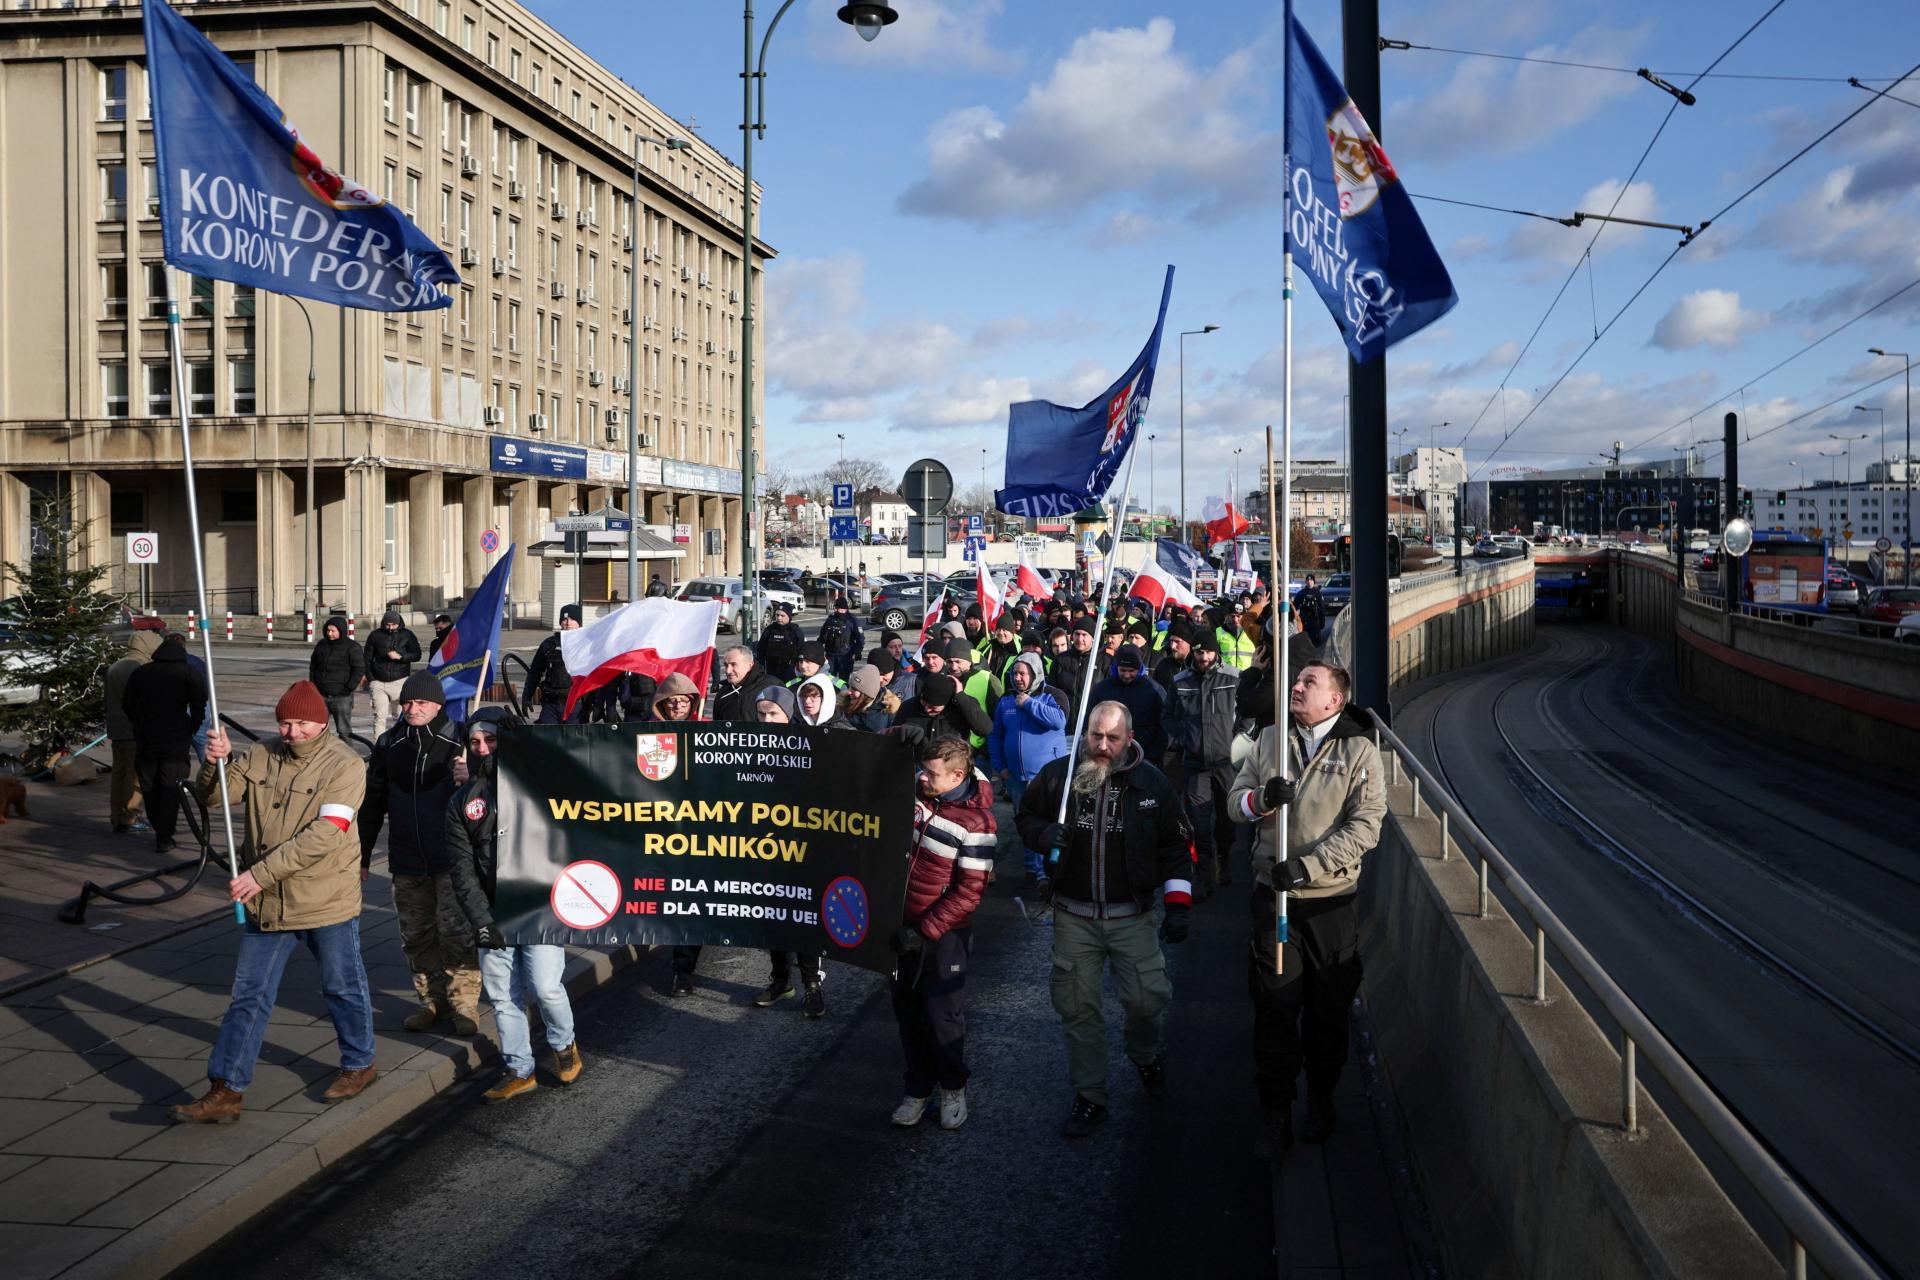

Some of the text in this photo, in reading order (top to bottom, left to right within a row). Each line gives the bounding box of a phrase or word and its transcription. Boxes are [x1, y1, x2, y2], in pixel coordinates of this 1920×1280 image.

[180, 217, 300, 277] KORONY
[136, 543, 150, 553] 30
[693, 732, 812, 750] KONFEDERACJA
[694, 751, 812, 769] KORONY POLSKIEJ
[736, 772, 775, 784] TARNÓW
[548, 798, 744, 823] WSPIERAMY
[751, 802, 880, 839] POLSKICH
[643, 832, 808, 863] ROLNIKÓW
[633, 878, 812, 900] NIE DLA MERCOSUR!
[625, 901, 818, 925] NIE DLA TERRORU UE!
